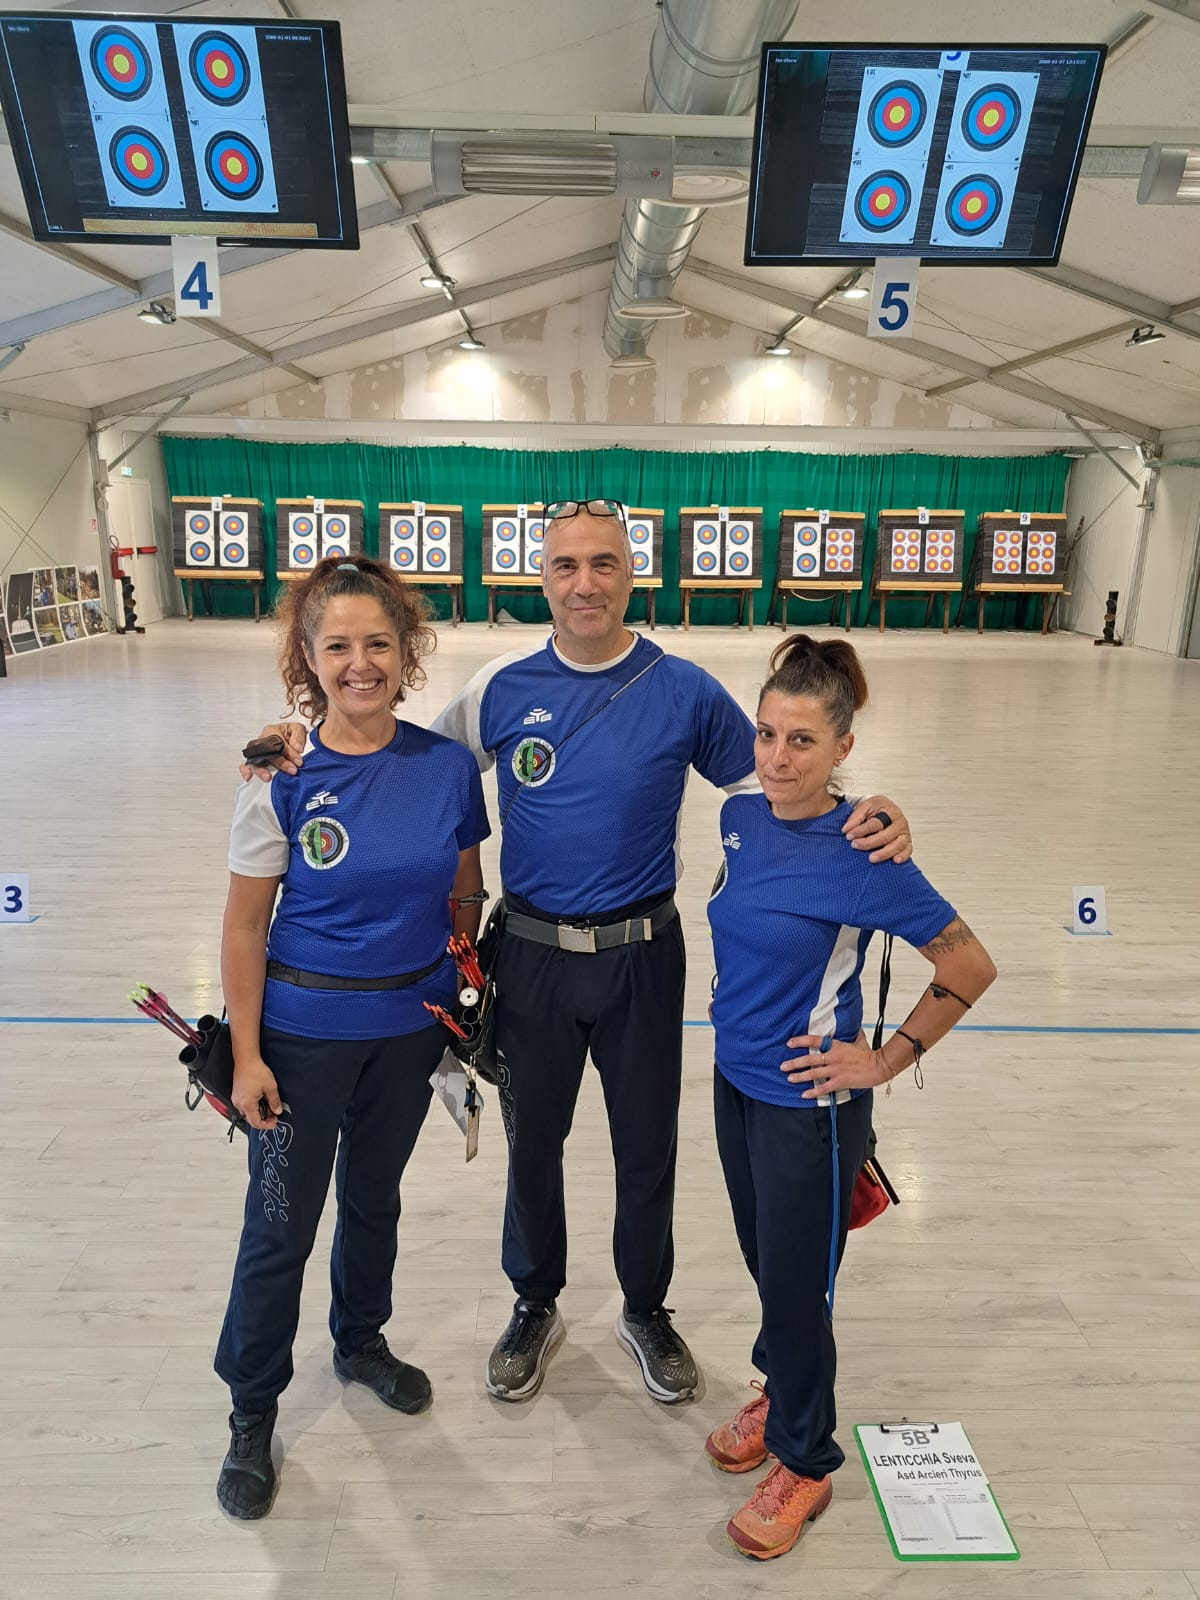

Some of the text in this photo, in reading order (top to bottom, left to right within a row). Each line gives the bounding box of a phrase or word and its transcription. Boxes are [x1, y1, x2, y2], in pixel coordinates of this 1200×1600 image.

[180, 261, 214, 310] 4
[878, 282, 911, 331] 5
[3, 885, 23, 914] 3
[1078, 897, 1097, 925] 6
[901, 1430, 931, 1447] 5B
[873, 1452, 977, 1467] LENTICCHIA Sveva
[897, 1468, 983, 1480] Asd Arcieri Thyrus
